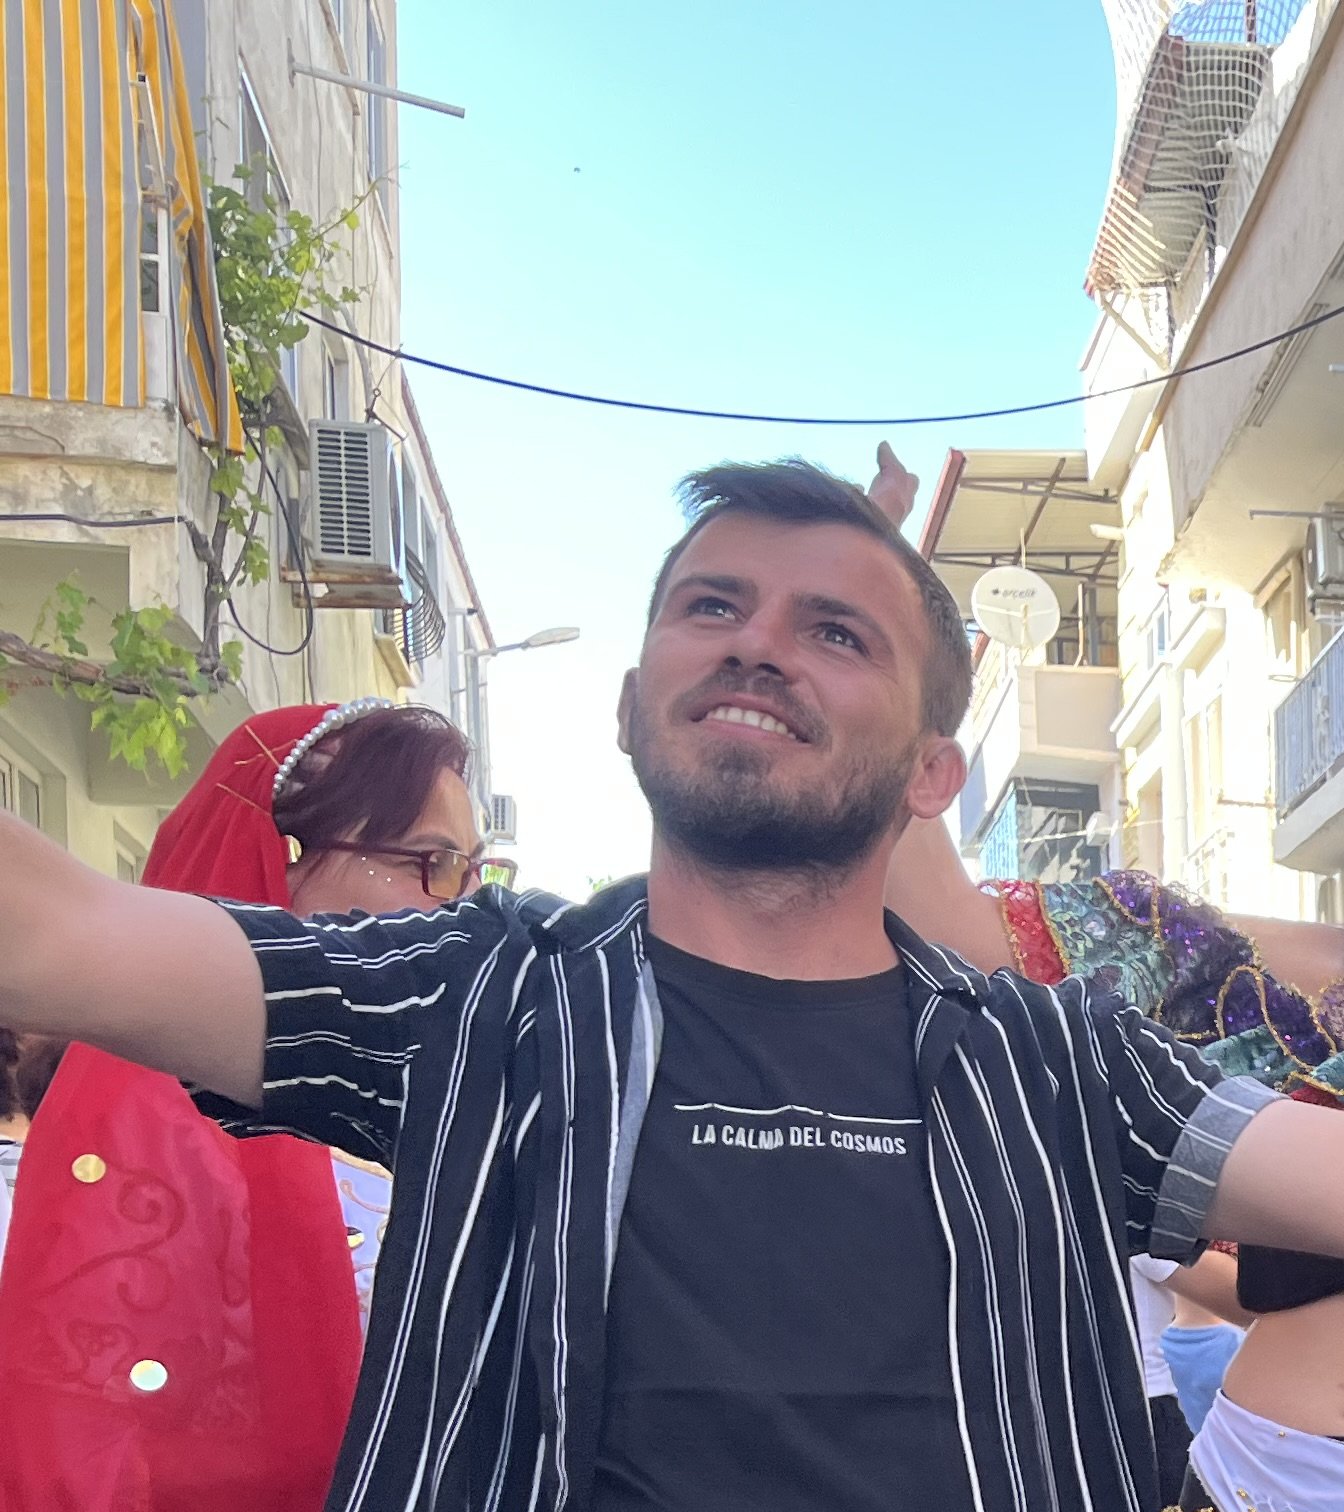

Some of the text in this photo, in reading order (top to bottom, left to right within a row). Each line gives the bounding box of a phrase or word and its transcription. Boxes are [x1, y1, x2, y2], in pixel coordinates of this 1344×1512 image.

[692, 1124, 907, 1155] LA CALMA DEL COSMOS
